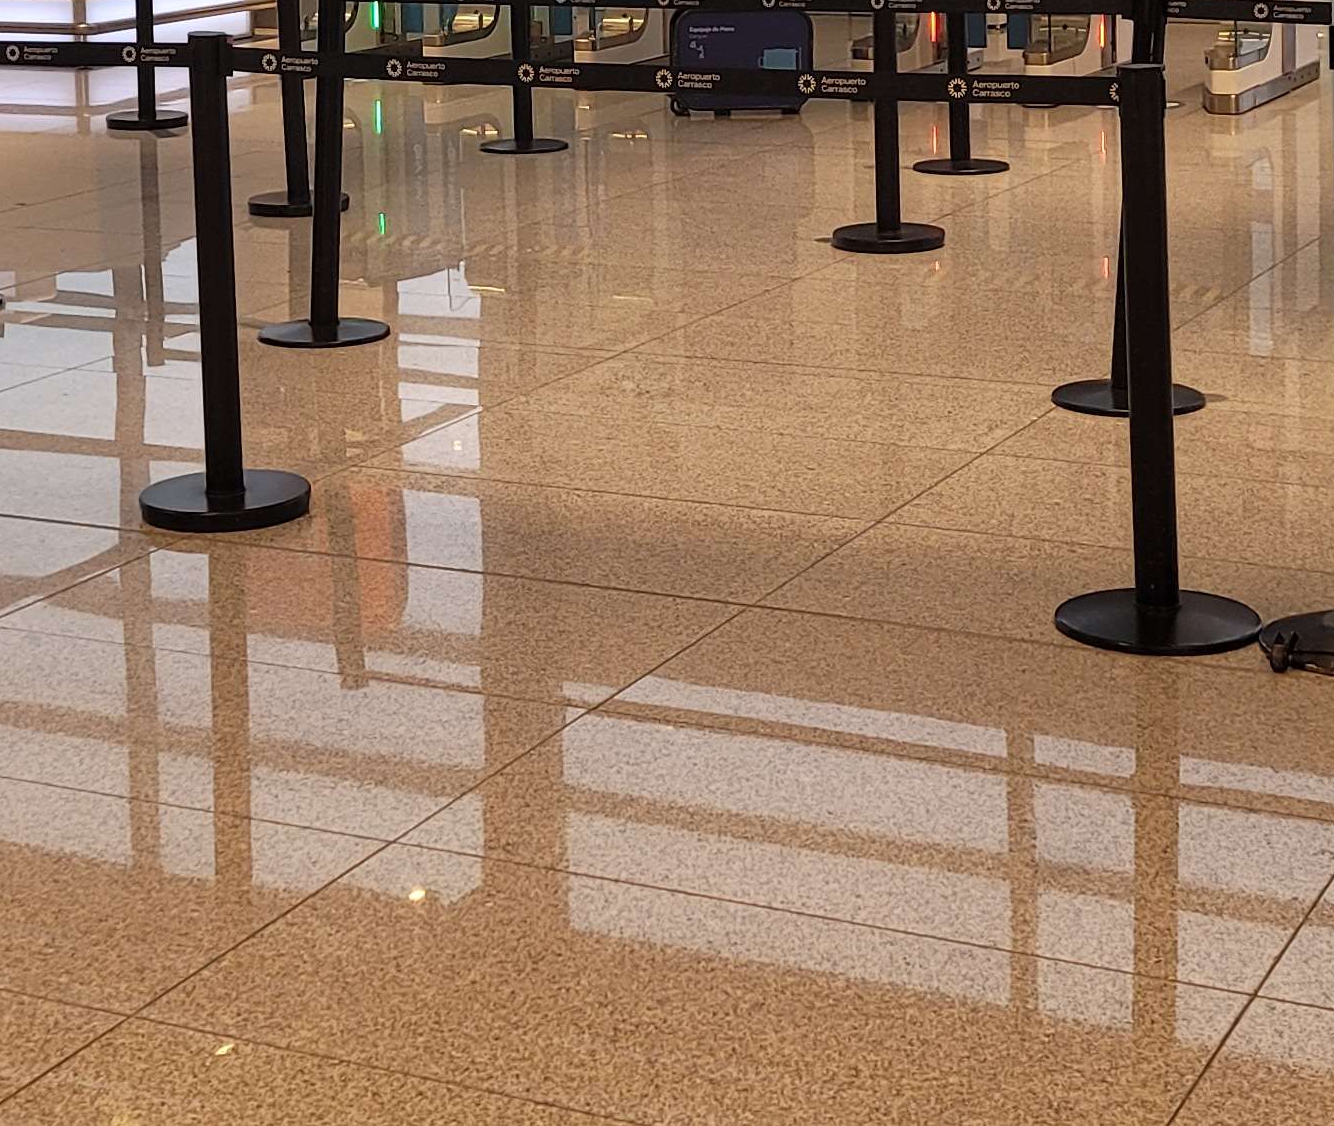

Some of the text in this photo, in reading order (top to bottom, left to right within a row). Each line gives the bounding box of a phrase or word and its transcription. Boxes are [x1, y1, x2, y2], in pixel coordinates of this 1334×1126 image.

[677, 72, 721, 81] Aeropuerto
[821, 76, 867, 86] Aeropuerto
[677, 80, 713, 89] Carrasco
[821, 84, 858, 94] Carrasco
[972, 80, 1020, 90] Aeropuerto
[972, 88, 1011, 98] Carrasco
